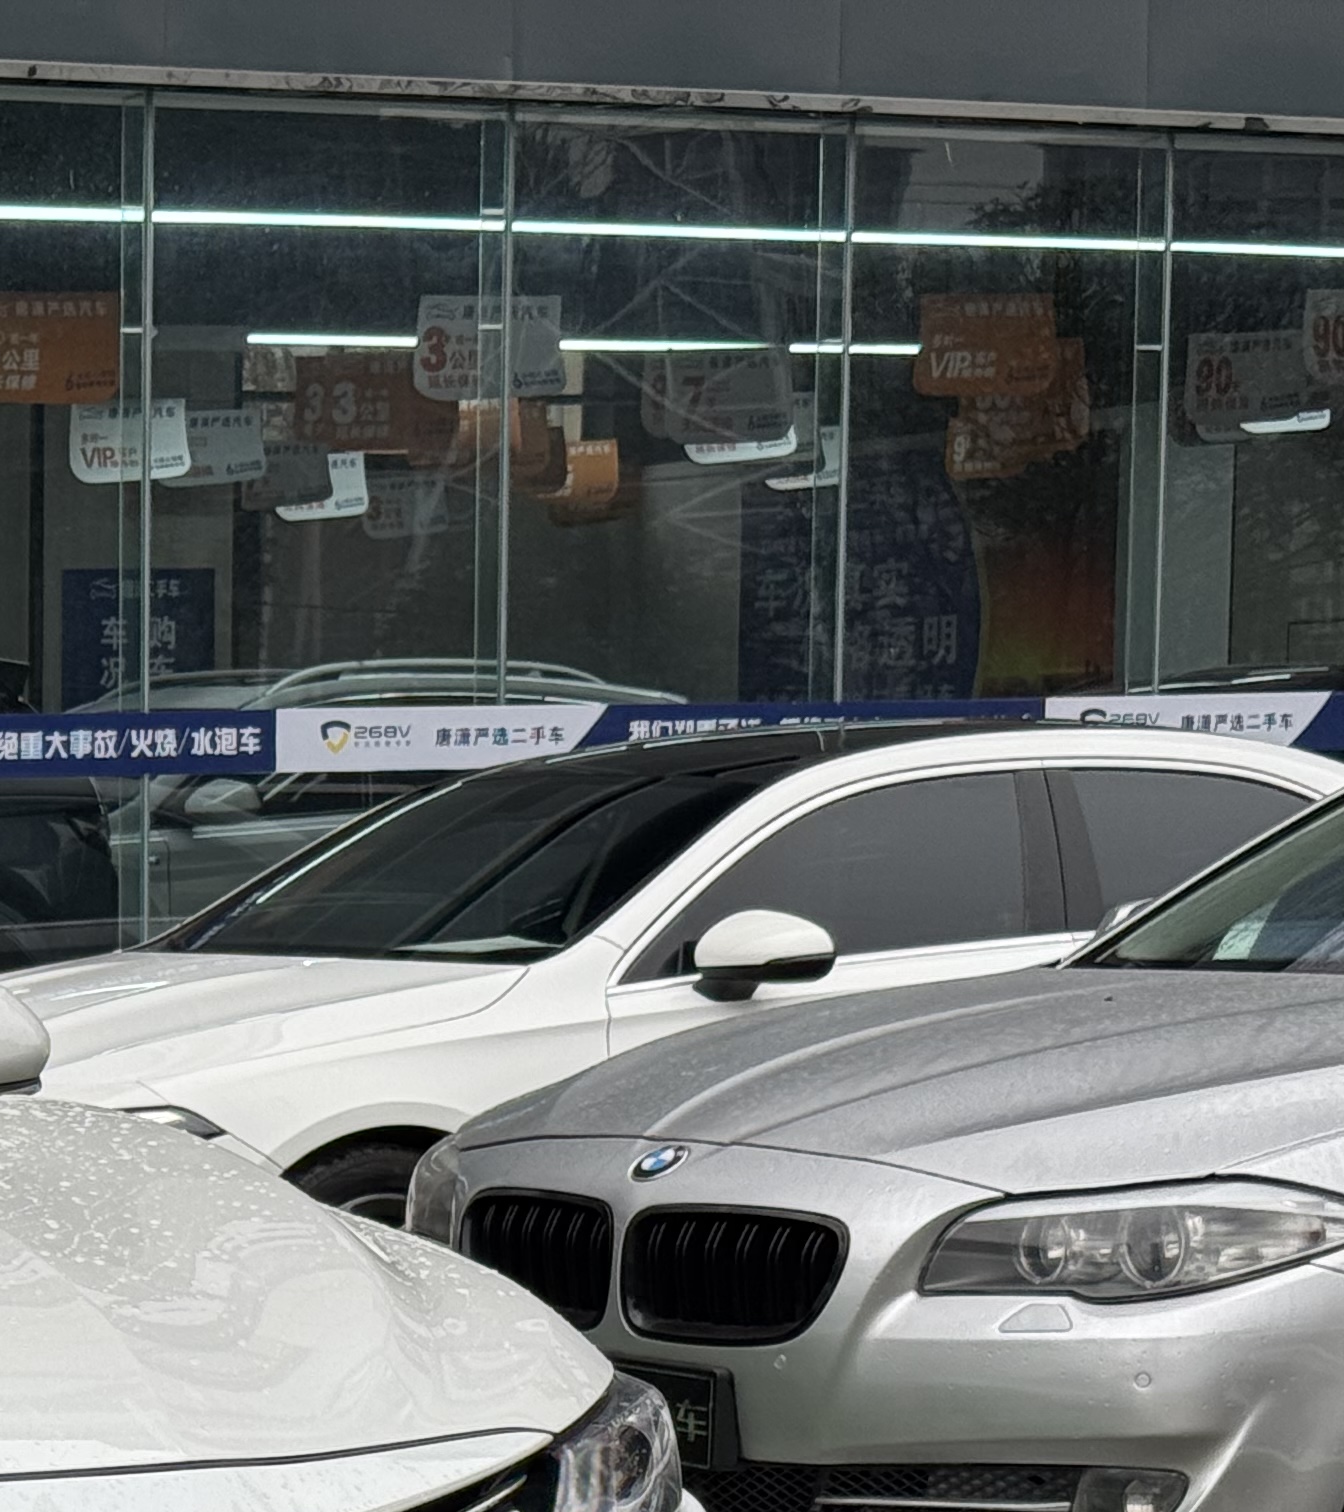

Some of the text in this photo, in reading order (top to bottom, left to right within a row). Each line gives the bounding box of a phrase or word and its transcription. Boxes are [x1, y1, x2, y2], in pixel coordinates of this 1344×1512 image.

[420, 326, 448, 372] 3
[1, 349, 40, 371] 公里
[930, 351, 972, 379] VIP
[80, 448, 115, 468] VIP
[354, 724, 411, 739] 268V
[1181, 712, 1294, 732] 唐潇严选二手车
[435, 727, 565, 746] 唐潇严选二手车
[676, 1399, 708, 1443] 车
